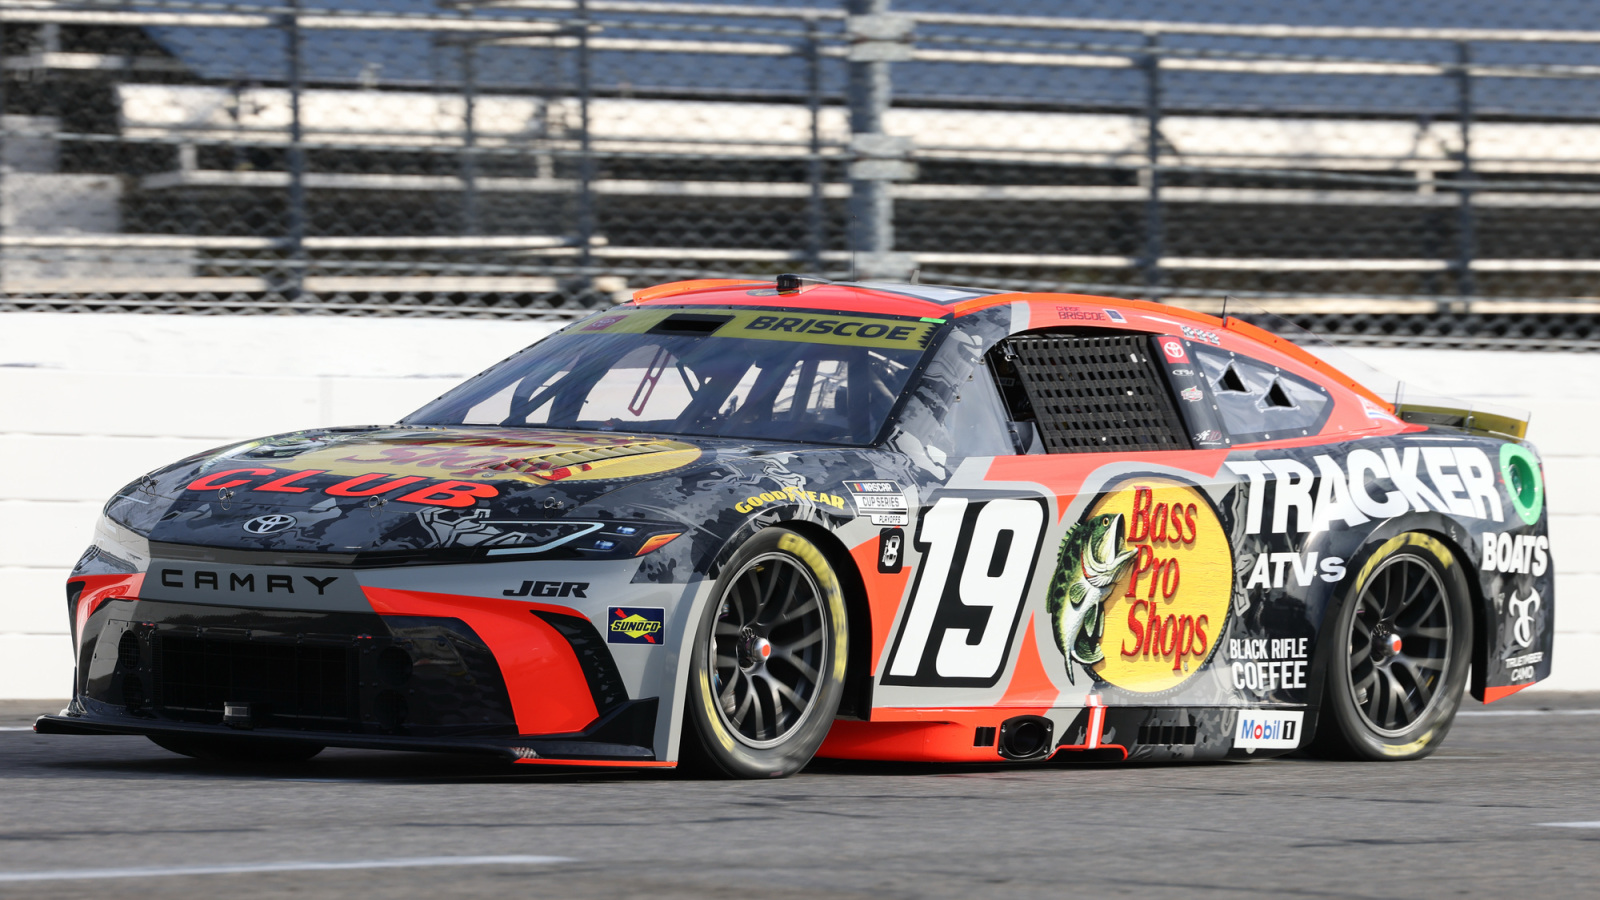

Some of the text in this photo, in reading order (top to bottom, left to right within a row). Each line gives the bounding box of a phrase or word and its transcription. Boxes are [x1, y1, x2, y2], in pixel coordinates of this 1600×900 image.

[745, 315, 916, 341] BRISCOE
[1058, 311, 1106, 320] BRISCOE
[186, 468, 499, 508] CLUB
[734, 485, 845, 514] GOODYEAR
[864, 483, 893, 492] NASCAR
[1224, 446, 1504, 534] TRACKER
[862, 497, 900, 507] CUP SERIES
[1127, 484, 1198, 544] Bass
[879, 515, 901, 523] PLAYOFFS
[1481, 532, 1548, 577] BOATS
[160, 568, 338, 596] CAMRY
[1125, 544, 1180, 600] Pro
[502, 580, 590, 598] JGR
[889, 497, 1044, 679] 19
[612, 620, 659, 632] SUNOCO
[1121, 600, 1208, 671] Shops
[1229, 637, 1308, 660] BLACK RIFLE
[1231, 660, 1308, 690] COFFEE
[1511, 665, 1535, 682] CAMO
[1241, 720, 1296, 740] Mobil 1
